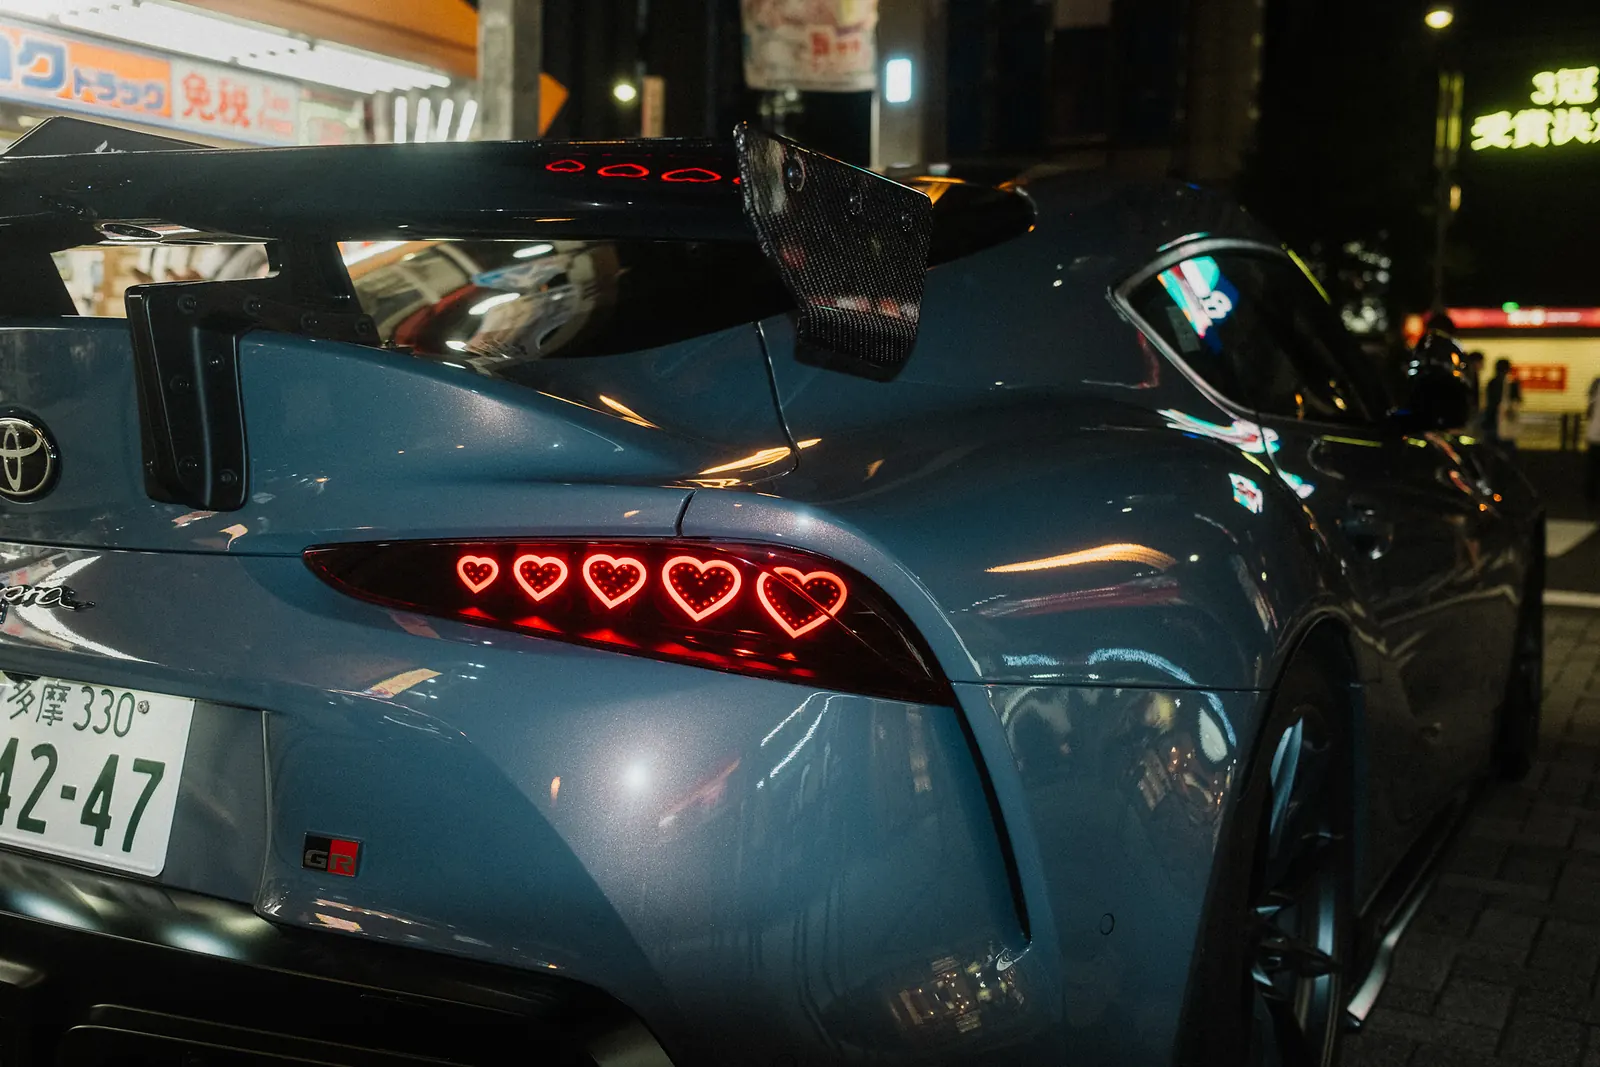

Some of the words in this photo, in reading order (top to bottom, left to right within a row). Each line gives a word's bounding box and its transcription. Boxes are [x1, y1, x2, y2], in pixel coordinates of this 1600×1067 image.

[183, 72, 250, 127] 免税
[7, 679, 71, 726] 多摩
[73, 686, 135, 737] 330
[304, 849, 354, 873] GR
